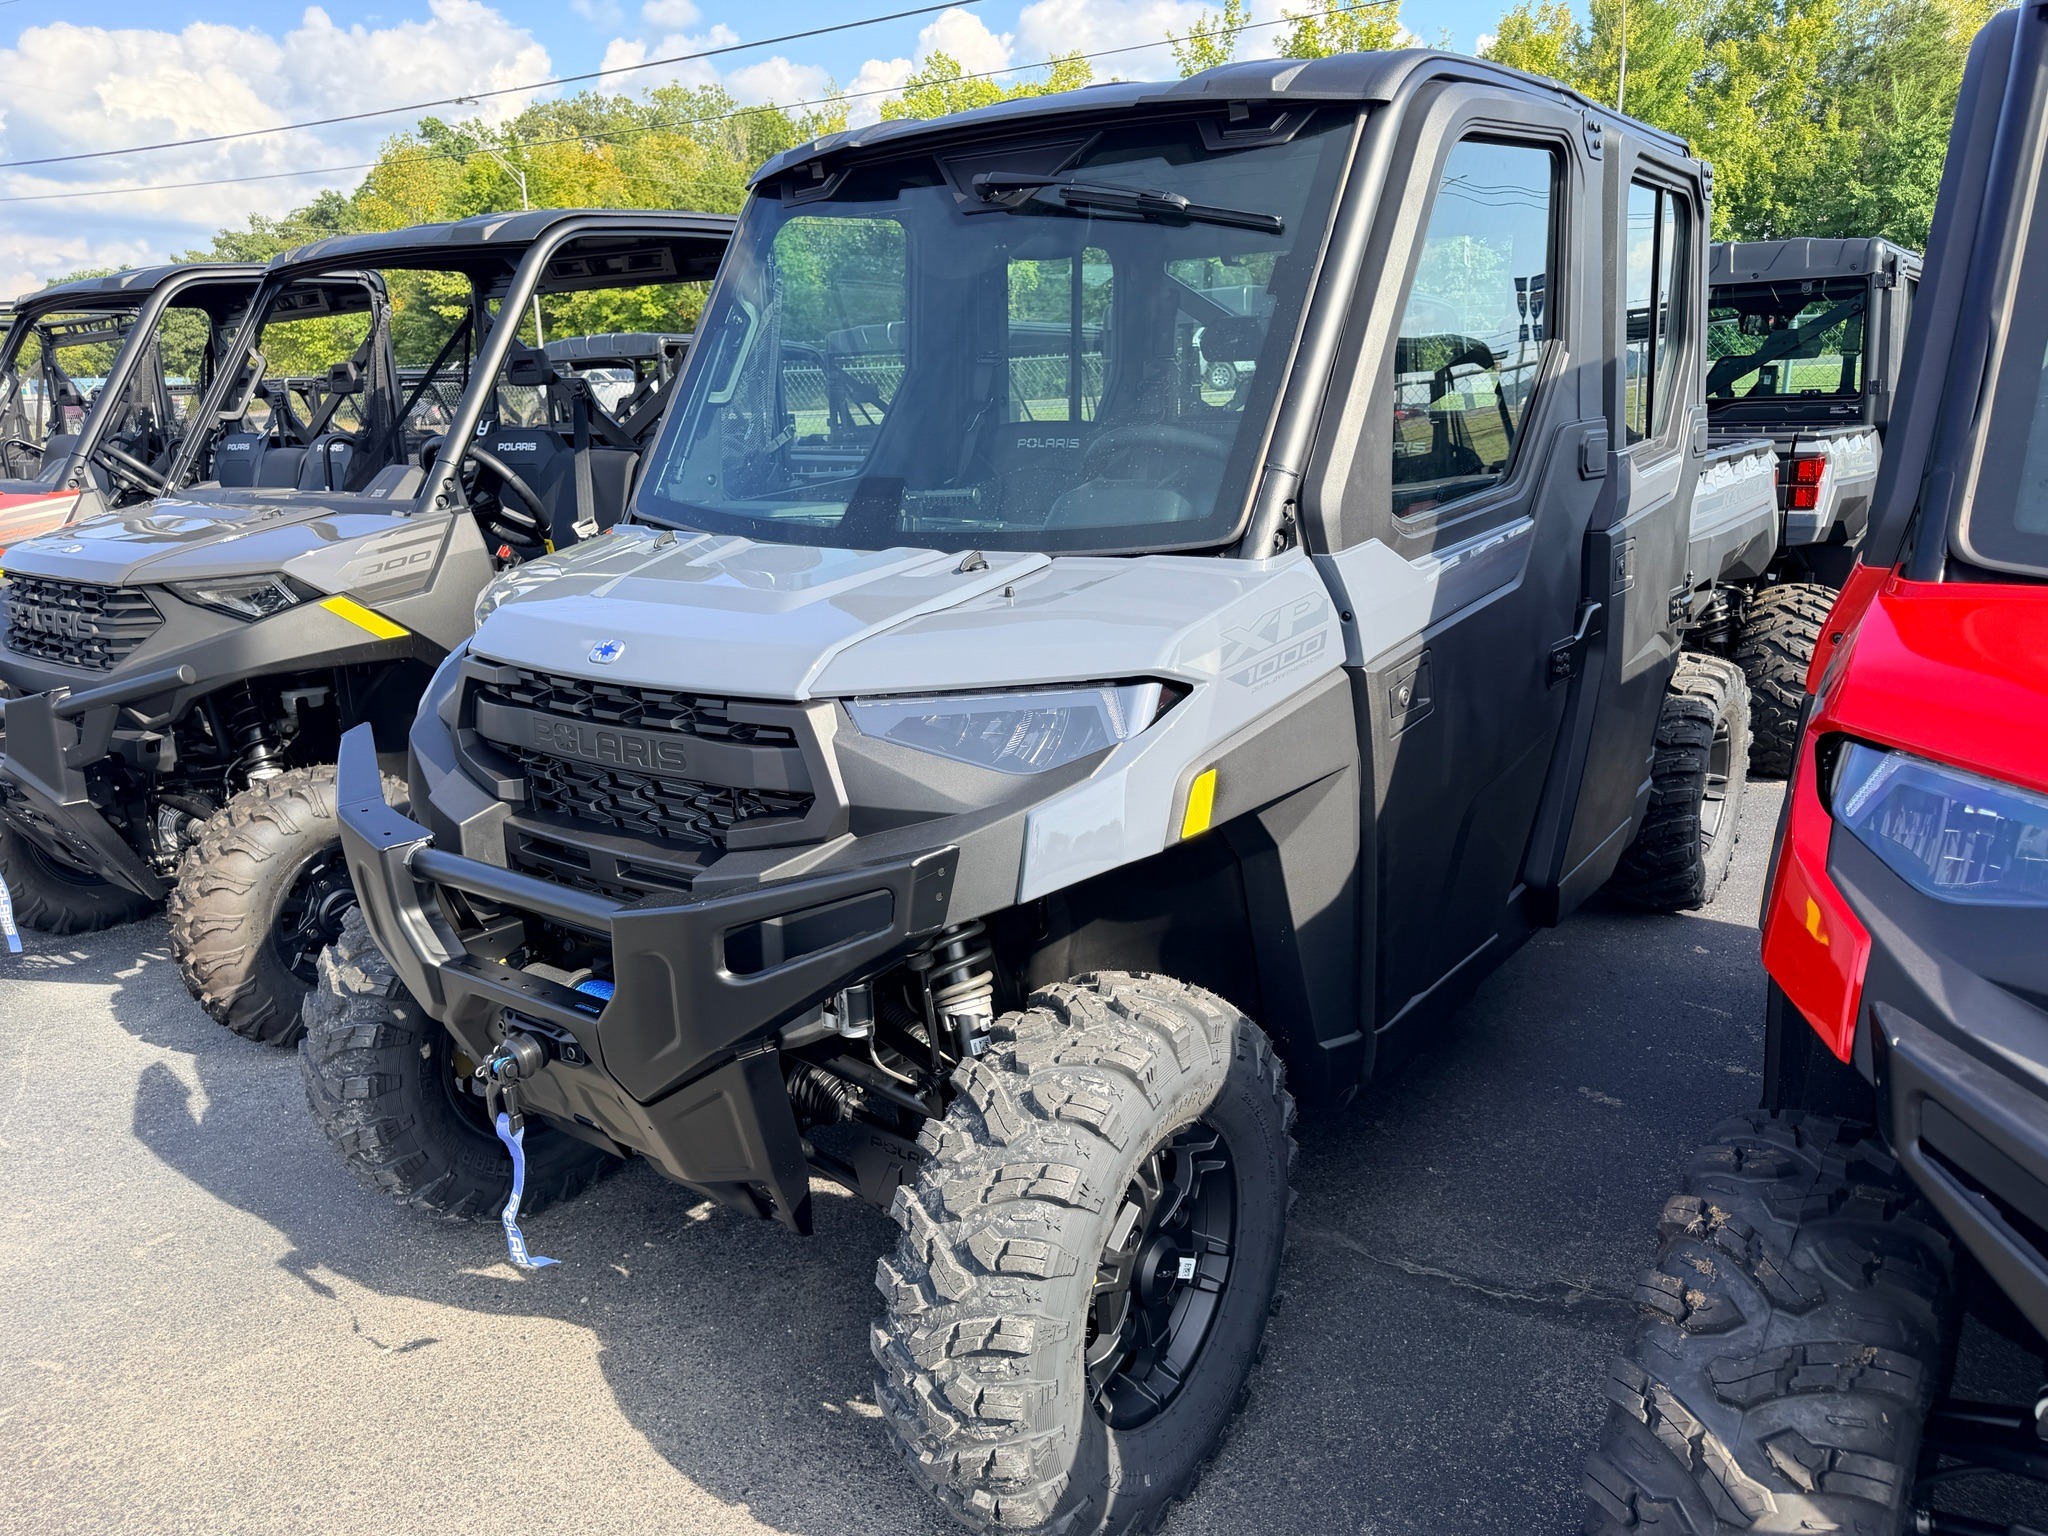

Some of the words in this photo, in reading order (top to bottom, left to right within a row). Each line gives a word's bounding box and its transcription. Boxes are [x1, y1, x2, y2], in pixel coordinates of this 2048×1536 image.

[226, 442, 250, 451] POLARIS
[316, 444, 345, 452] PARIS
[497, 442, 537, 452] POLARIS
[1017, 438, 1080, 448] POLARIS
[8, 602, 100, 639] POLARIS
[1217, 590, 1329, 672] XP
[1245, 631, 1325, 687] 1000
[533, 717, 688, 773] POLARIS
